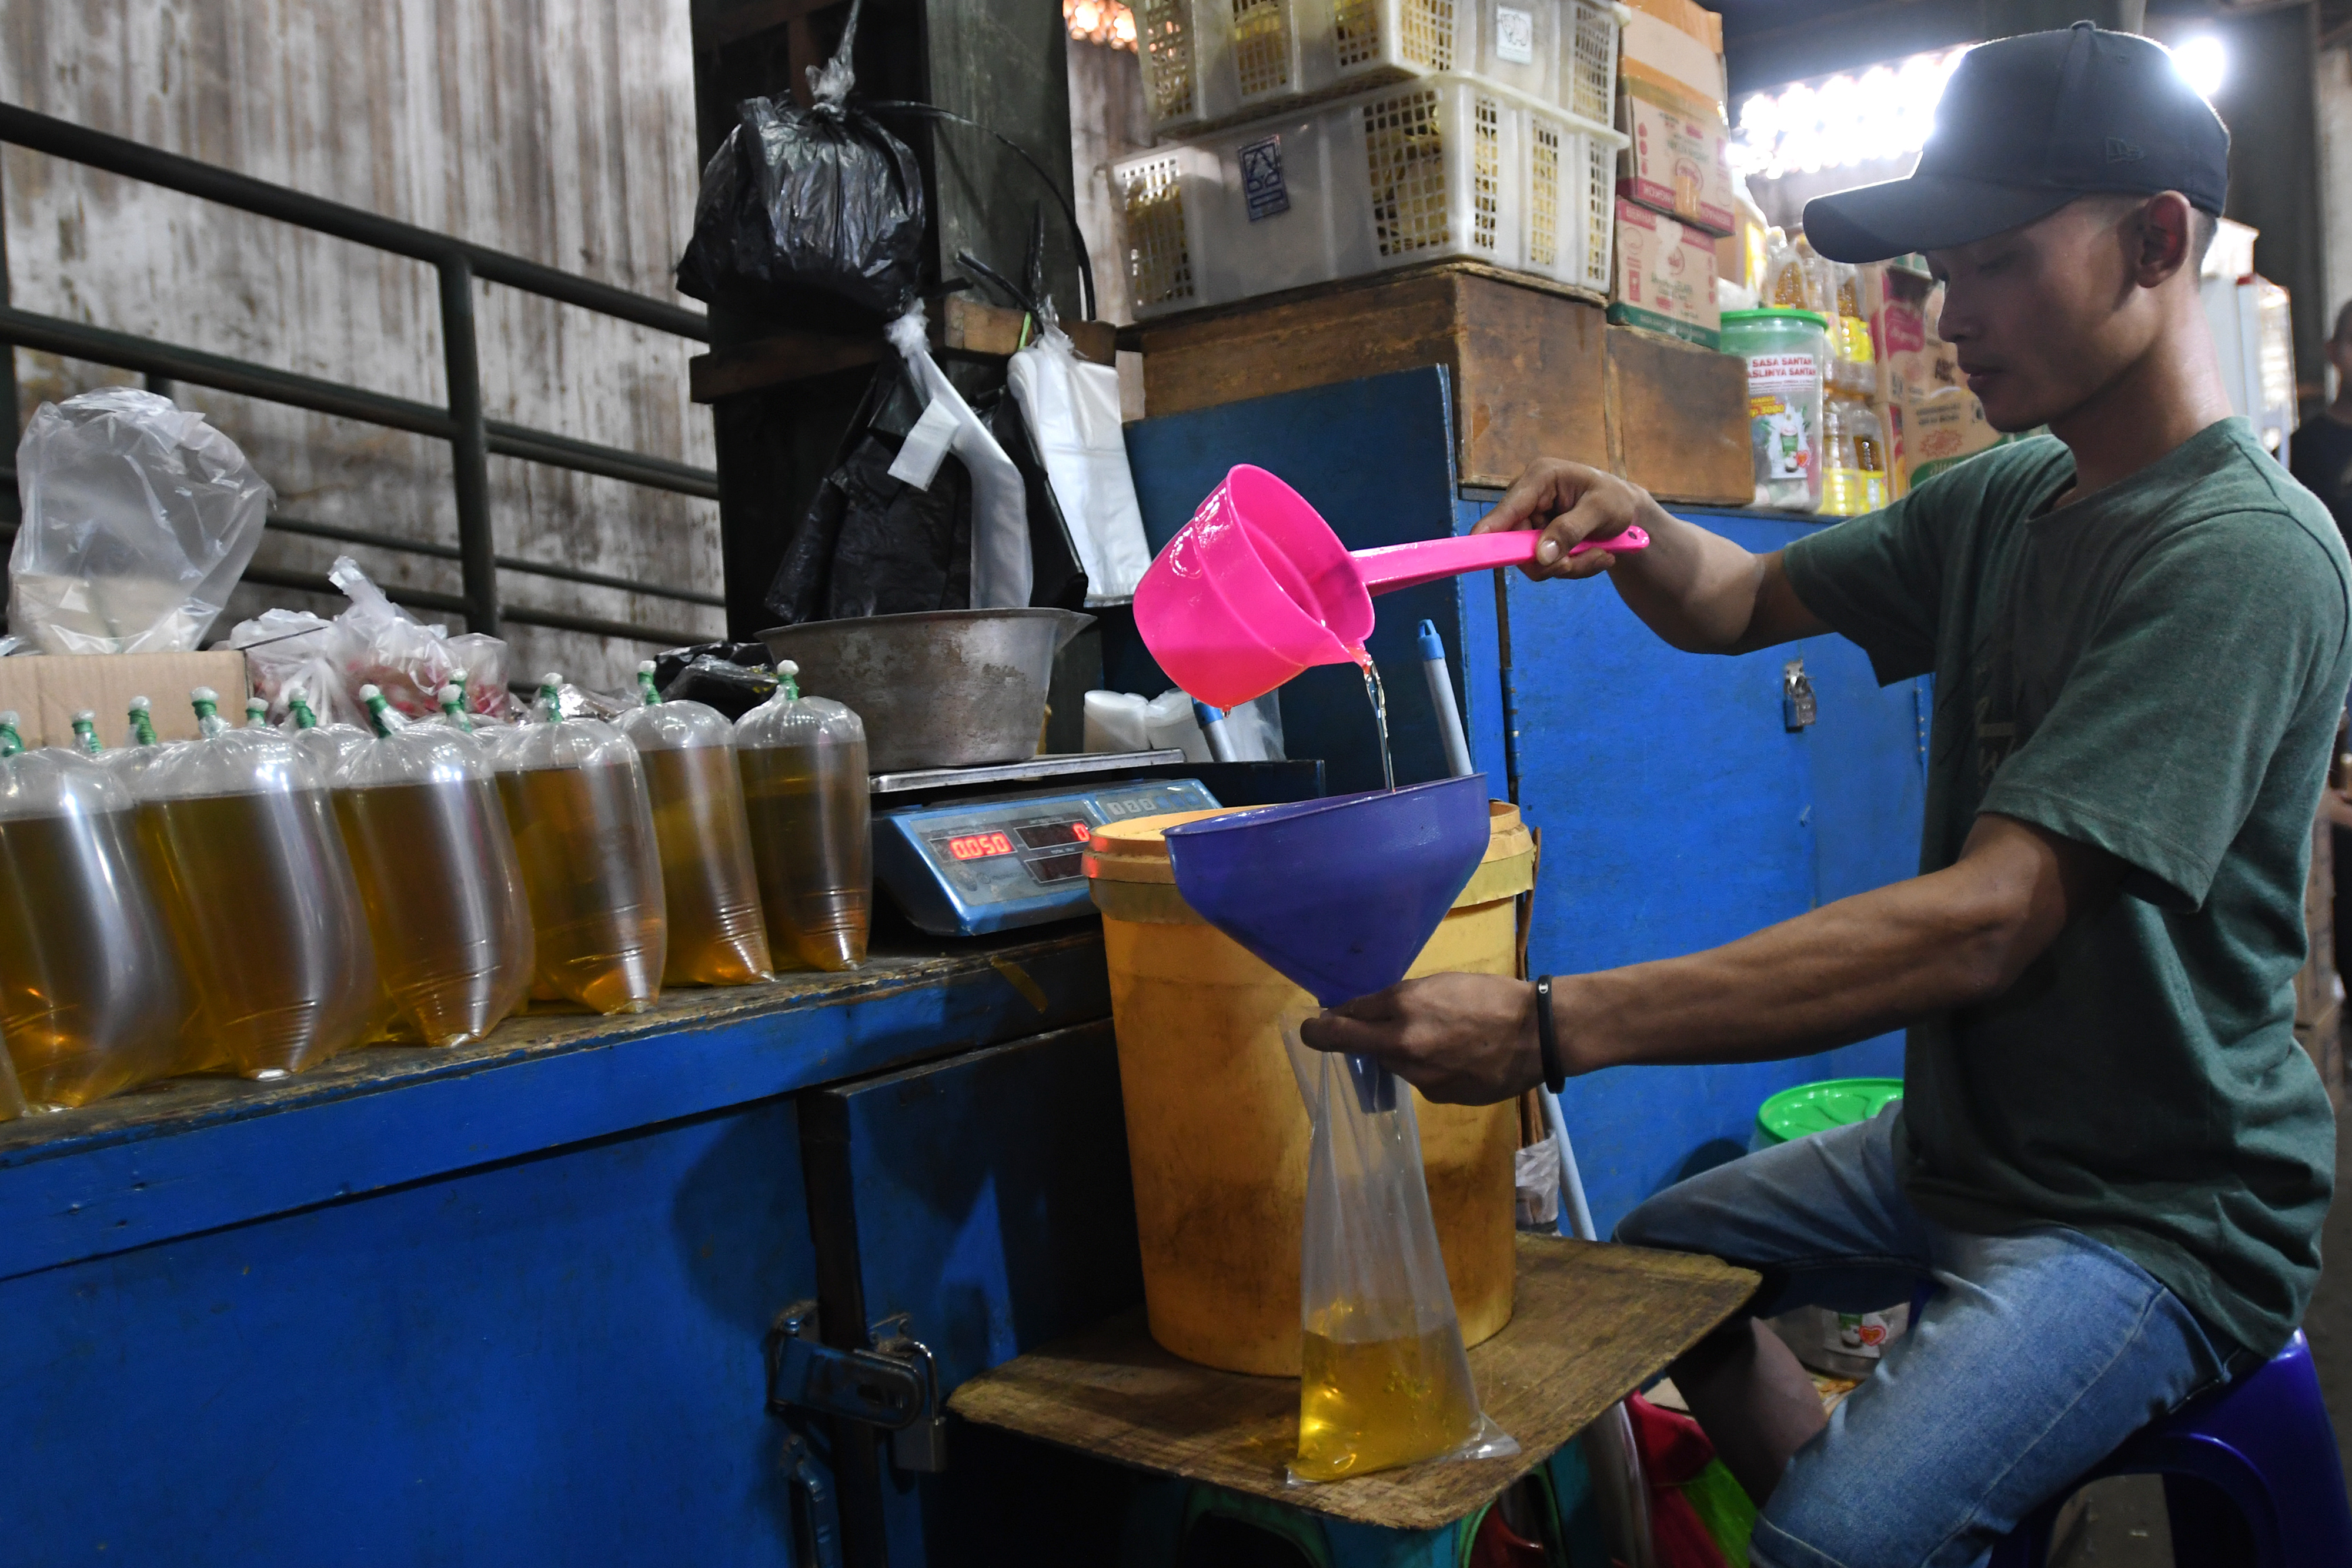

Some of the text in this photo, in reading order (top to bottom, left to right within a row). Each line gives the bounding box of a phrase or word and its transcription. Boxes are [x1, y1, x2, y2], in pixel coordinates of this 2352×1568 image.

[1752, 357, 1812, 367] SASA SANTAN
[1789, 367, 1816, 376] SANTAN
